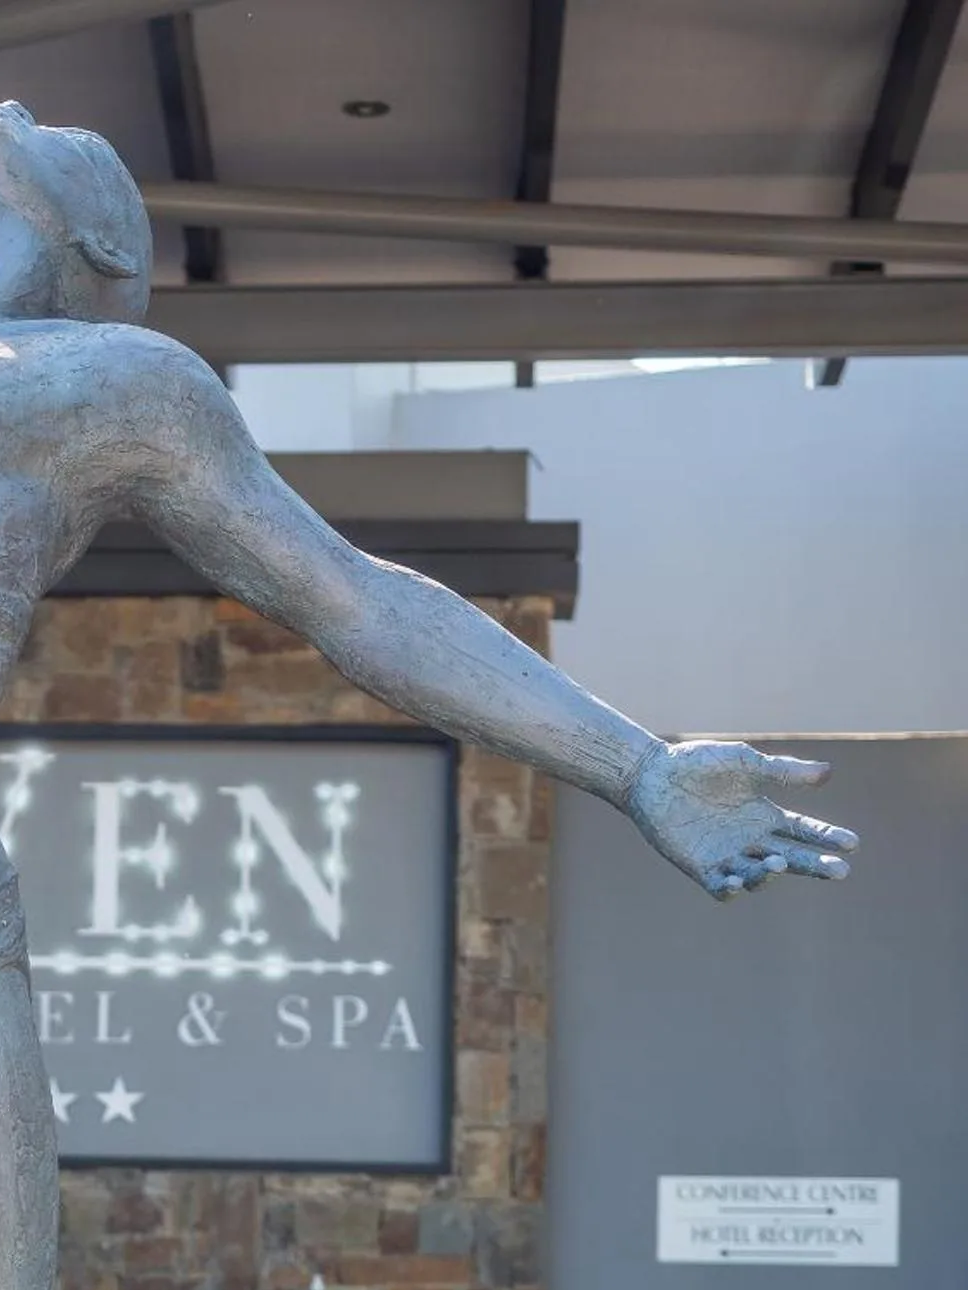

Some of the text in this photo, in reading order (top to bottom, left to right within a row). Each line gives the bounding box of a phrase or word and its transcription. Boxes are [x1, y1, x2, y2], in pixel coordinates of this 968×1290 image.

[177, 991, 231, 1045] &
[275, 994, 423, 1051] SPA
[690, 1225, 864, 1246] HOTEL RECEPTION
